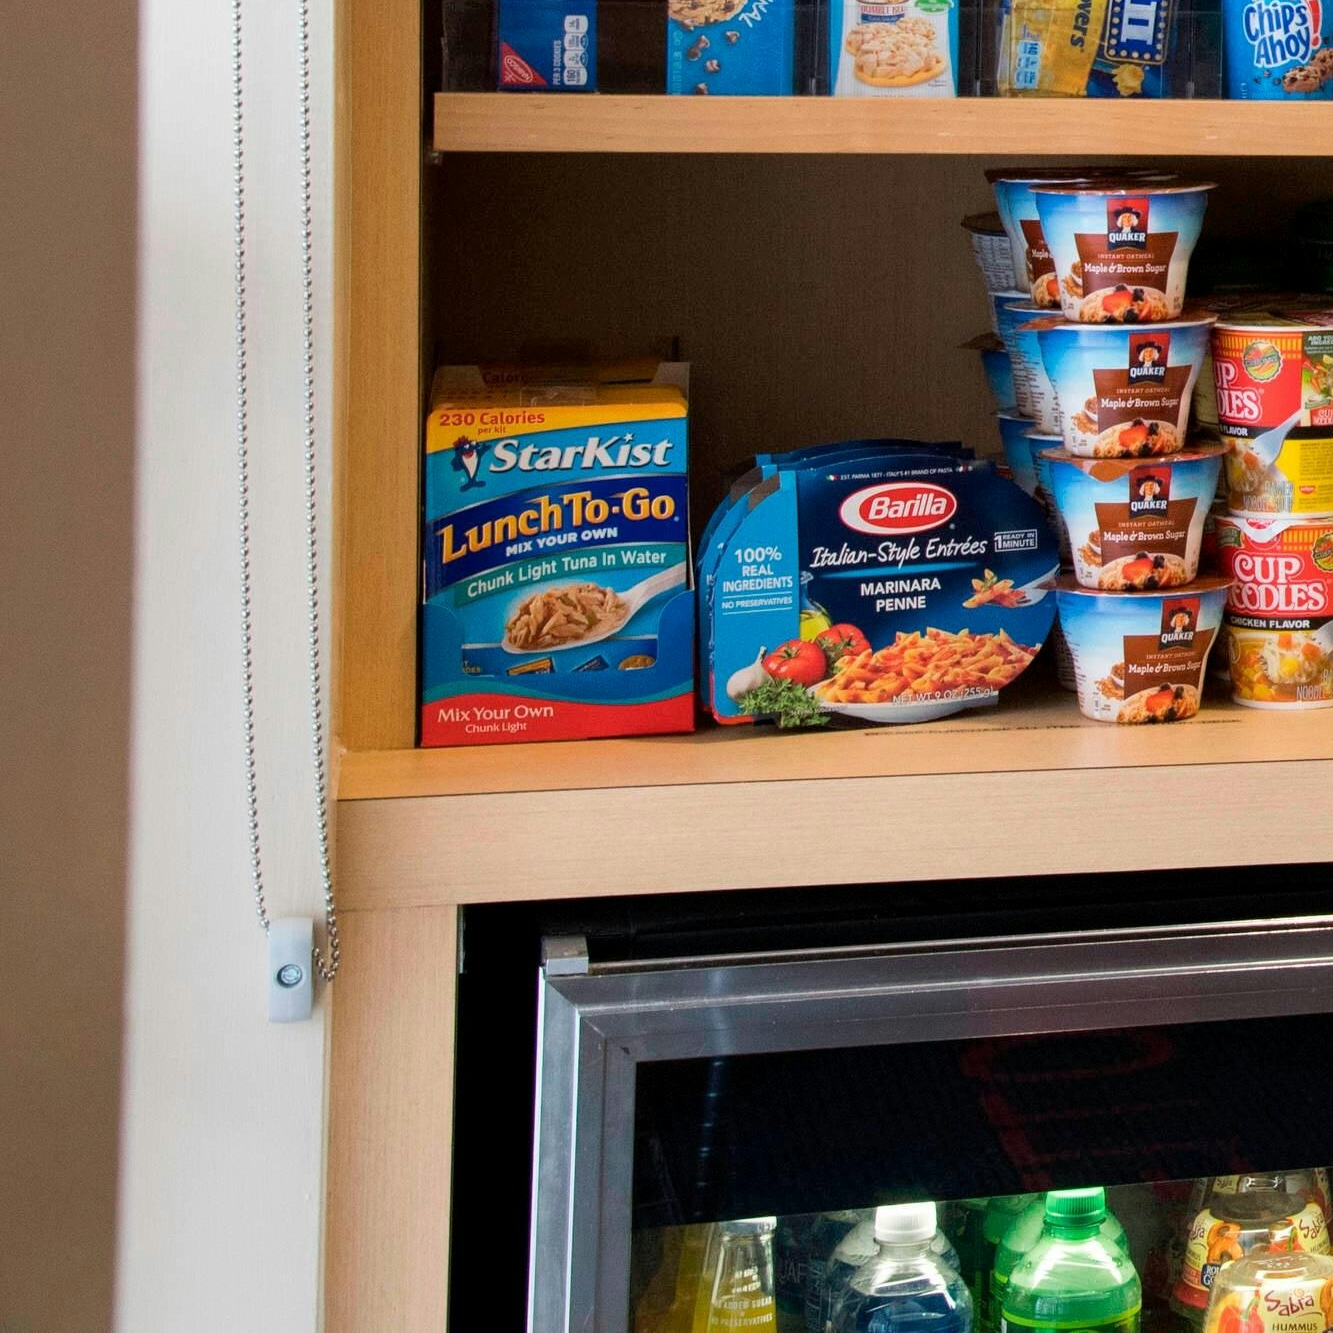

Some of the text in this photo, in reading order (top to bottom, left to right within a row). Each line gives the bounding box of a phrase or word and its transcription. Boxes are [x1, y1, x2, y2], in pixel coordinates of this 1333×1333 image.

[1108, 231, 1147, 244] QUAKER
[1084, 264, 1144, 275] Maple Brown
[1129, 365, 1166, 377] QUAKER
[439, 410, 545, 427] 230 Calories
[489, 432, 675, 473] StarKist
[868, 492, 947, 520] Barilla
[436, 491, 559, 564] Lunch
[505, 527, 618, 557] MIX YOUR OWN
[1003, 538, 1036, 549] MINUTE
[810, 535, 988, 569] Italian-Style Entrées
[467, 550, 667, 598] Chunk Light Tuna In Water
[742, 564, 774, 577] REAL
[1234, 555, 1301, 584] CUP
[722, 575, 793, 593] INGREDIENTS
[860, 578, 942, 597] MARINARA
[736, 596, 793, 609] PRESERVATIVES
[876, 596, 927, 613] PENNE
[1231, 617, 1311, 629] CHICKEN FLAVOR
[437, 704, 554, 723] Mix Your Own
[465, 721, 527, 734] Chunk Light
[1264, 1290, 1315, 1317] Sabra
